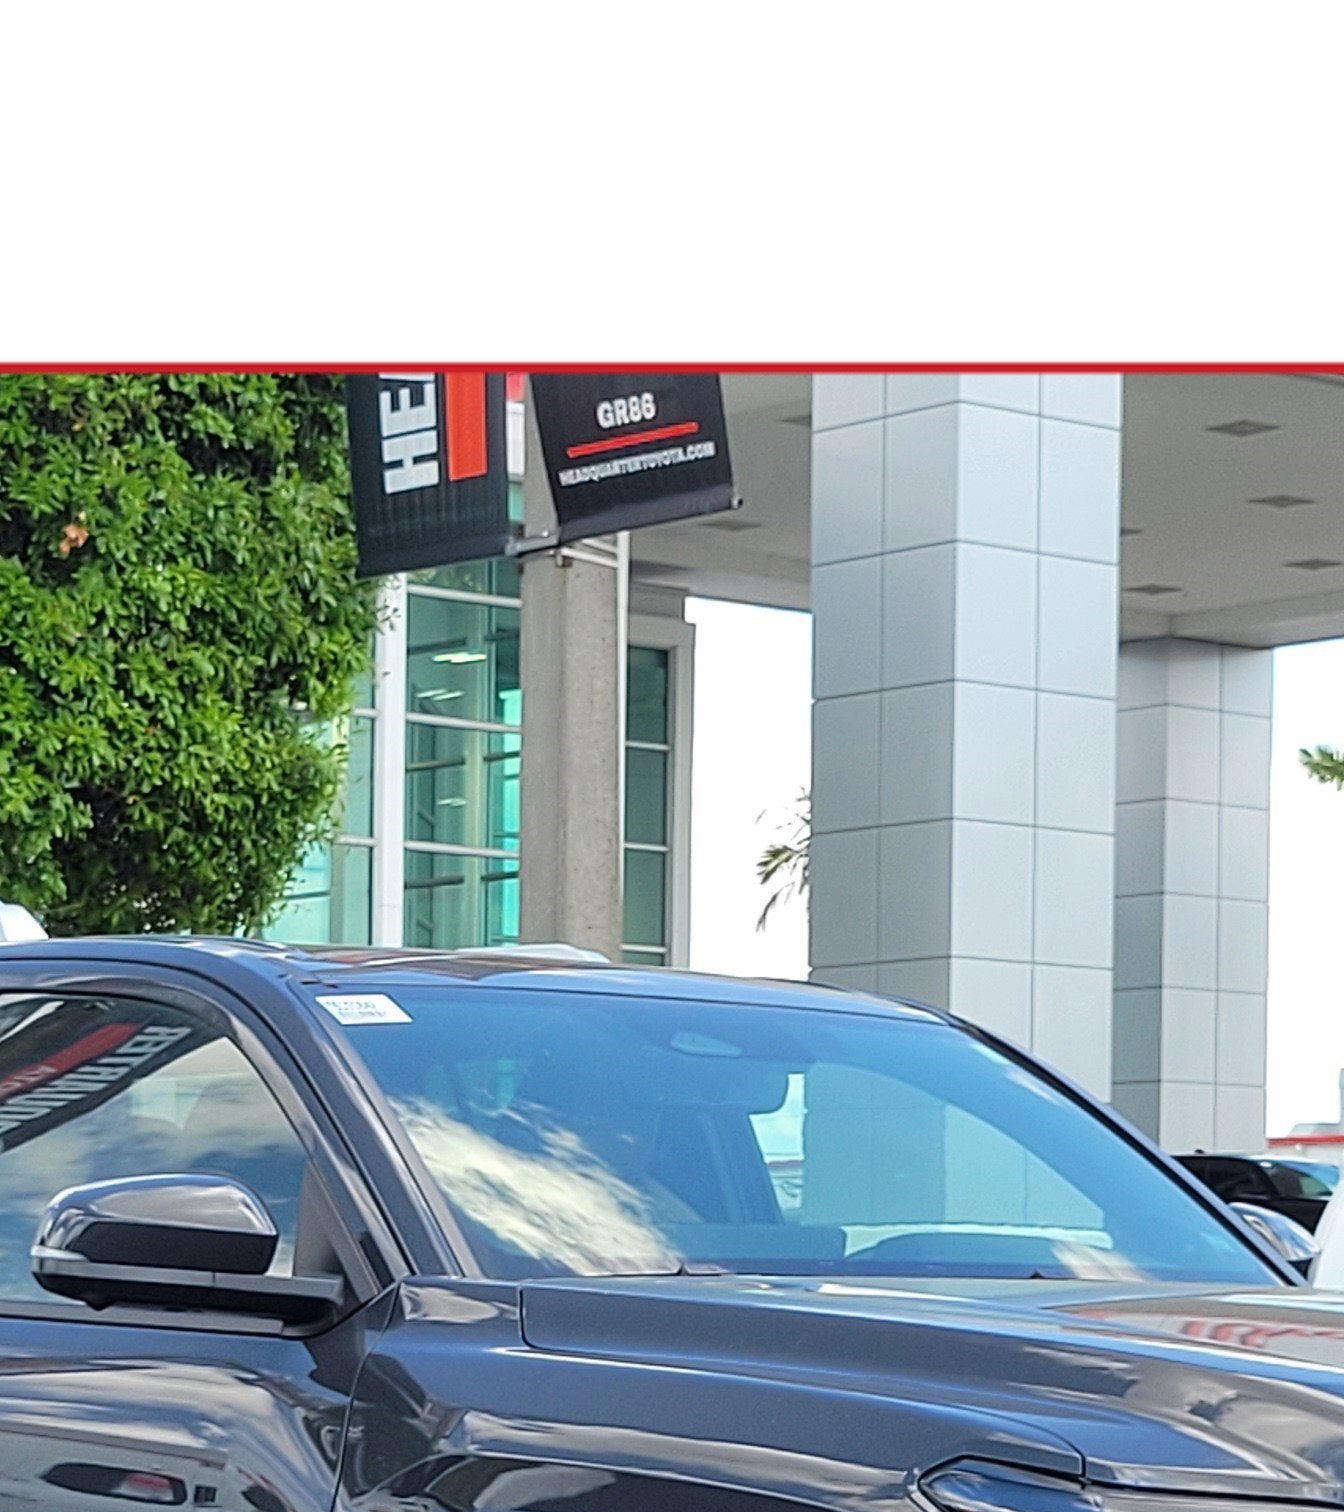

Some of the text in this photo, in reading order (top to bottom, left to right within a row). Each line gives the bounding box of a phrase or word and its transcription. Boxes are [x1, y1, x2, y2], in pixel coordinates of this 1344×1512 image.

[597, 392, 656, 429] GR86
[378, 373, 440, 495] HE
[558, 441, 716, 487] HEADQUARTERTOYOTA.COM
